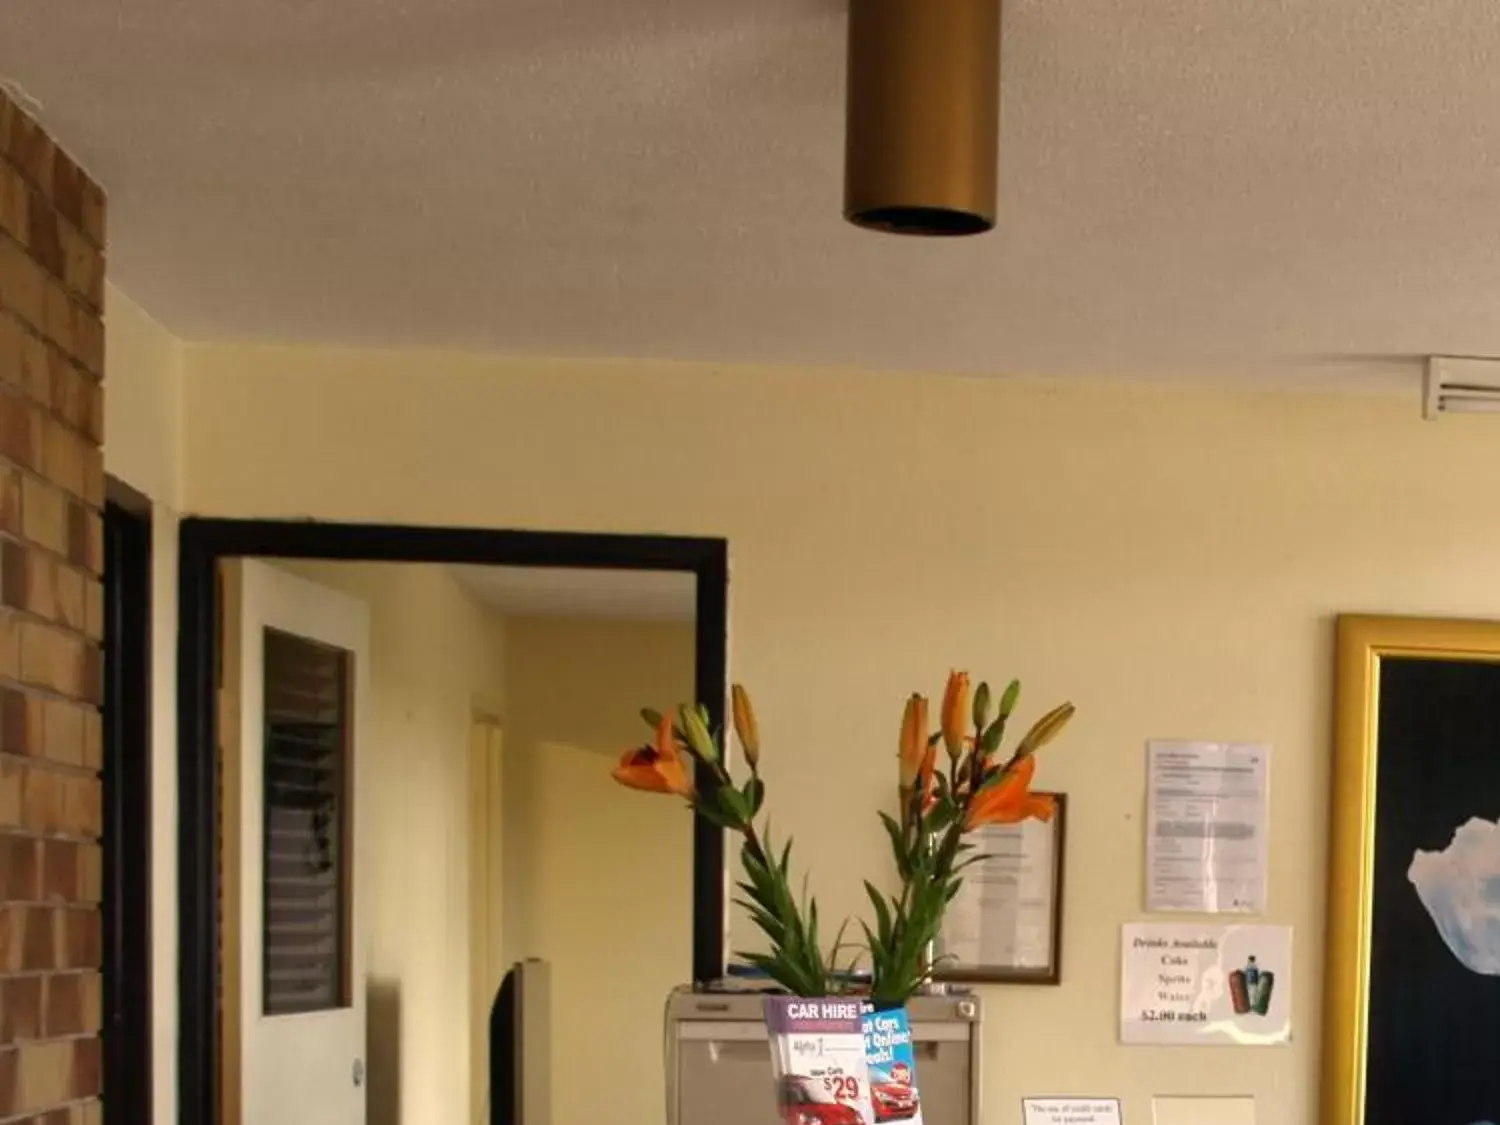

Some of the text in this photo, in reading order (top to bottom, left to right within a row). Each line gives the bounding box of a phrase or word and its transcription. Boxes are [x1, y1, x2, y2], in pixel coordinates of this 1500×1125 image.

[1132, 937, 1218, 950] Drinks Available
[1161, 955, 1188, 966] Coke
[1158, 974, 1191, 986] Sprite
[787, 1003, 858, 1019] CAR HIRE
[1177, 1010, 1207, 1021] each
